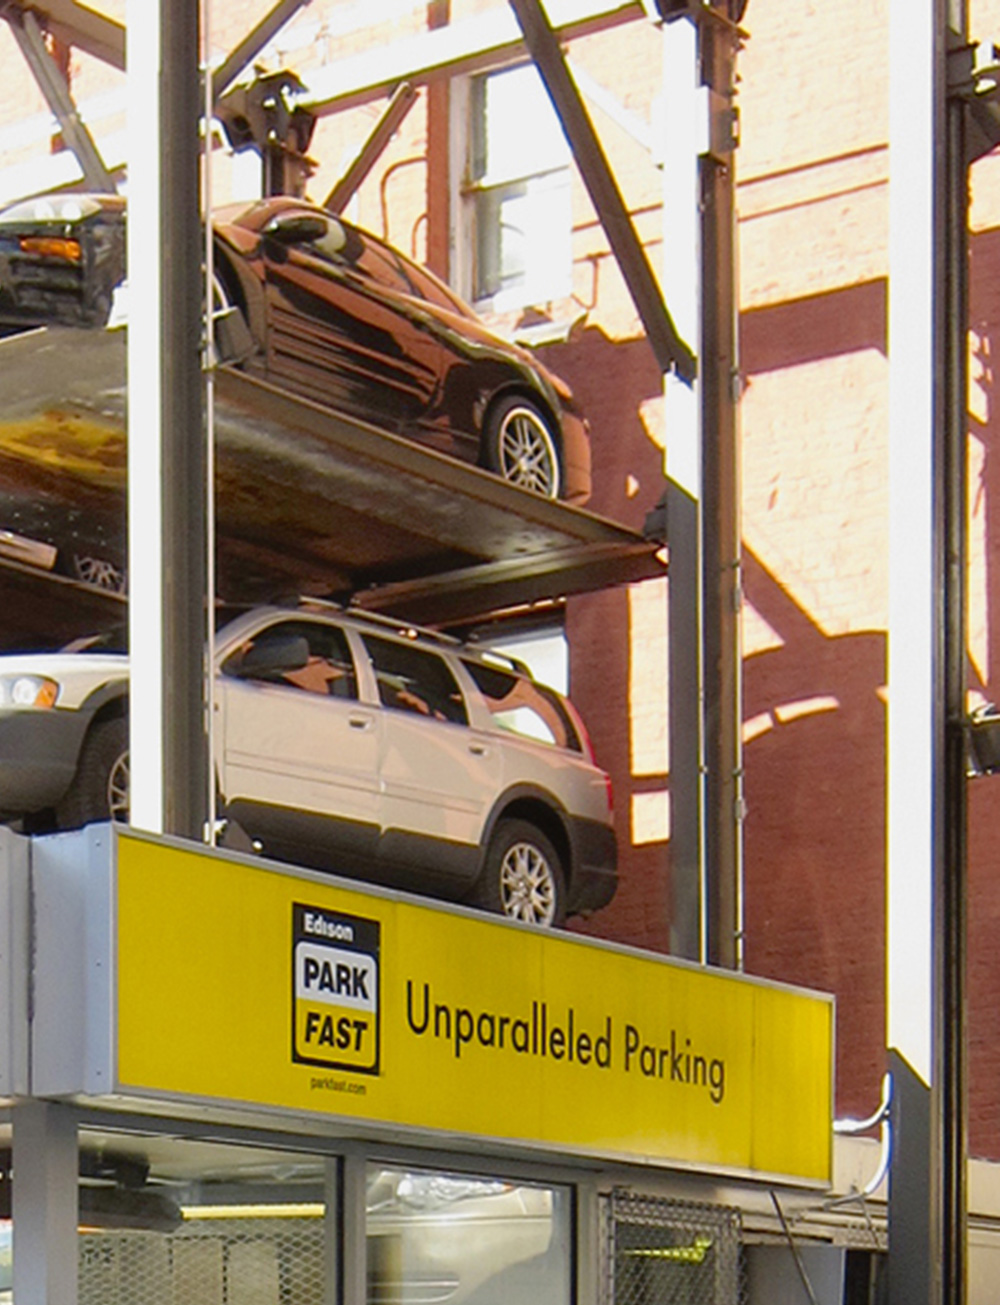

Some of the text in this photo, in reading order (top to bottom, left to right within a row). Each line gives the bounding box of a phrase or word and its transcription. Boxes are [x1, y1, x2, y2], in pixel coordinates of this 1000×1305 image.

[305, 914, 354, 941] Edison
[304, 958, 369, 1001] PARK
[305, 1013, 368, 1053] FAST
[406, 980, 725, 1104] Unparalleled Parking
[310, 1075, 367, 1096] parkfast.com
